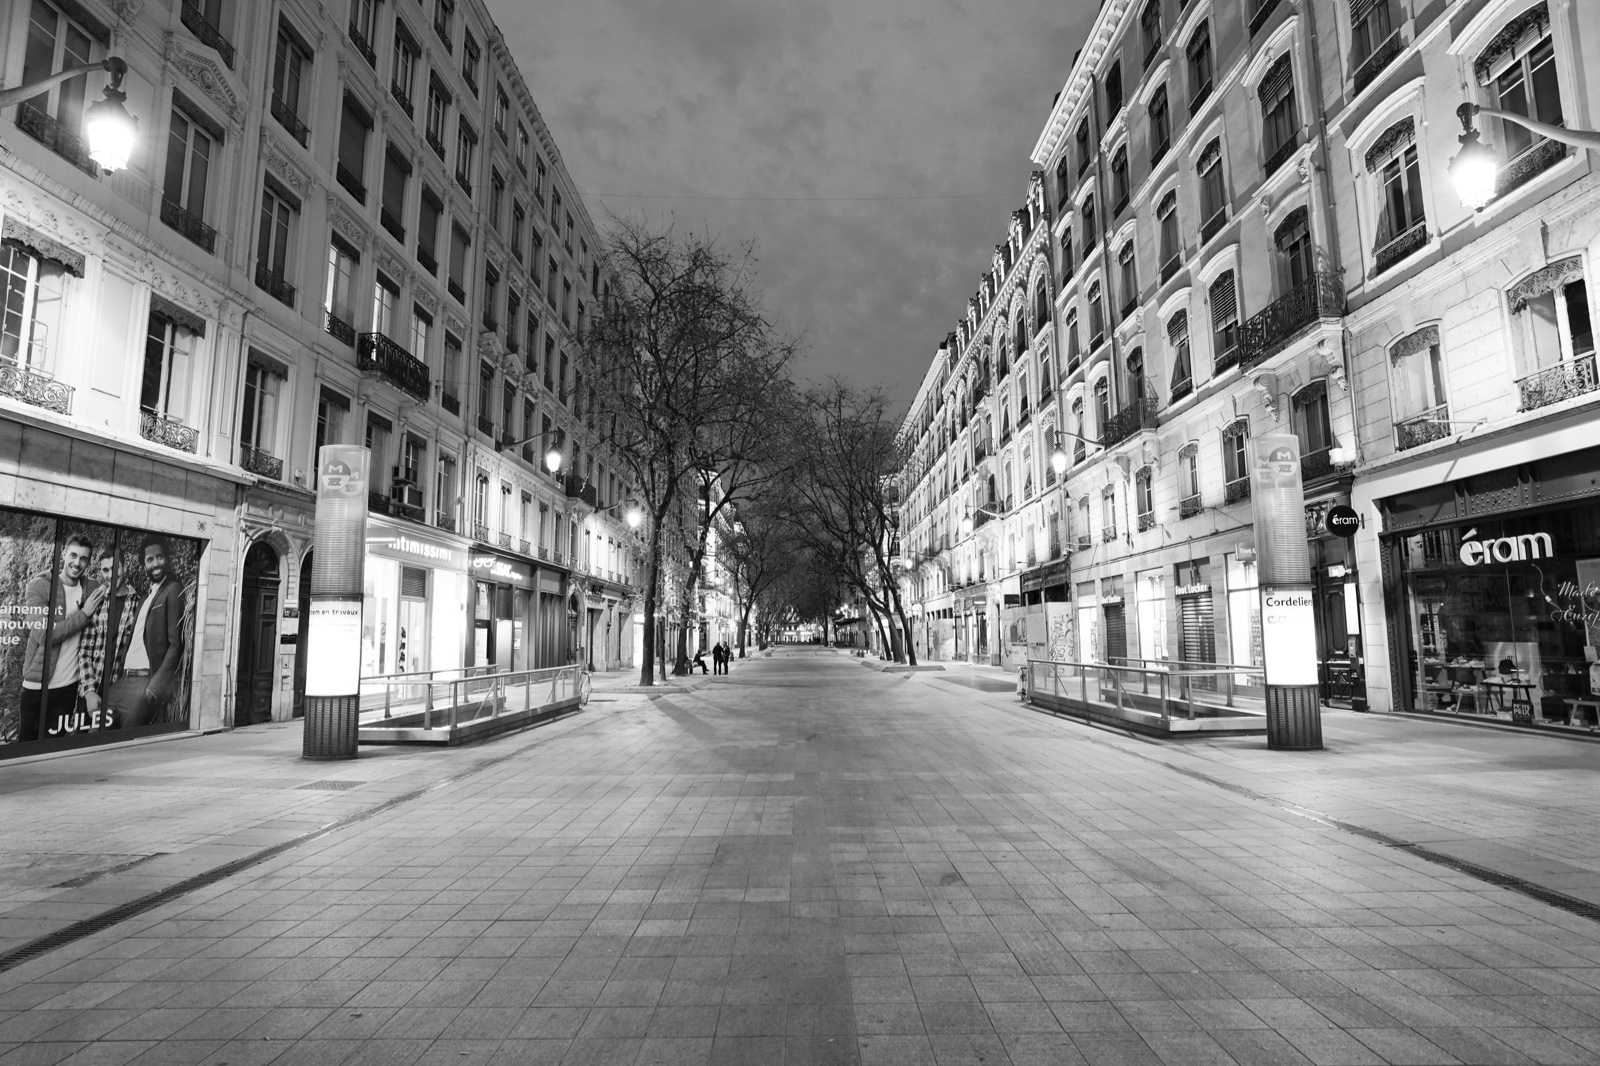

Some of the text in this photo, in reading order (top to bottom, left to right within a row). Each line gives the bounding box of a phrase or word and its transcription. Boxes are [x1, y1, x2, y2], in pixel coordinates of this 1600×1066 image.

[1276, 451, 1291, 460] M
[328, 464, 343, 473] M
[1332, 514, 1358, 525] éram
[1460, 528, 1553, 566] éram
[48, 709, 114, 735] JULES
